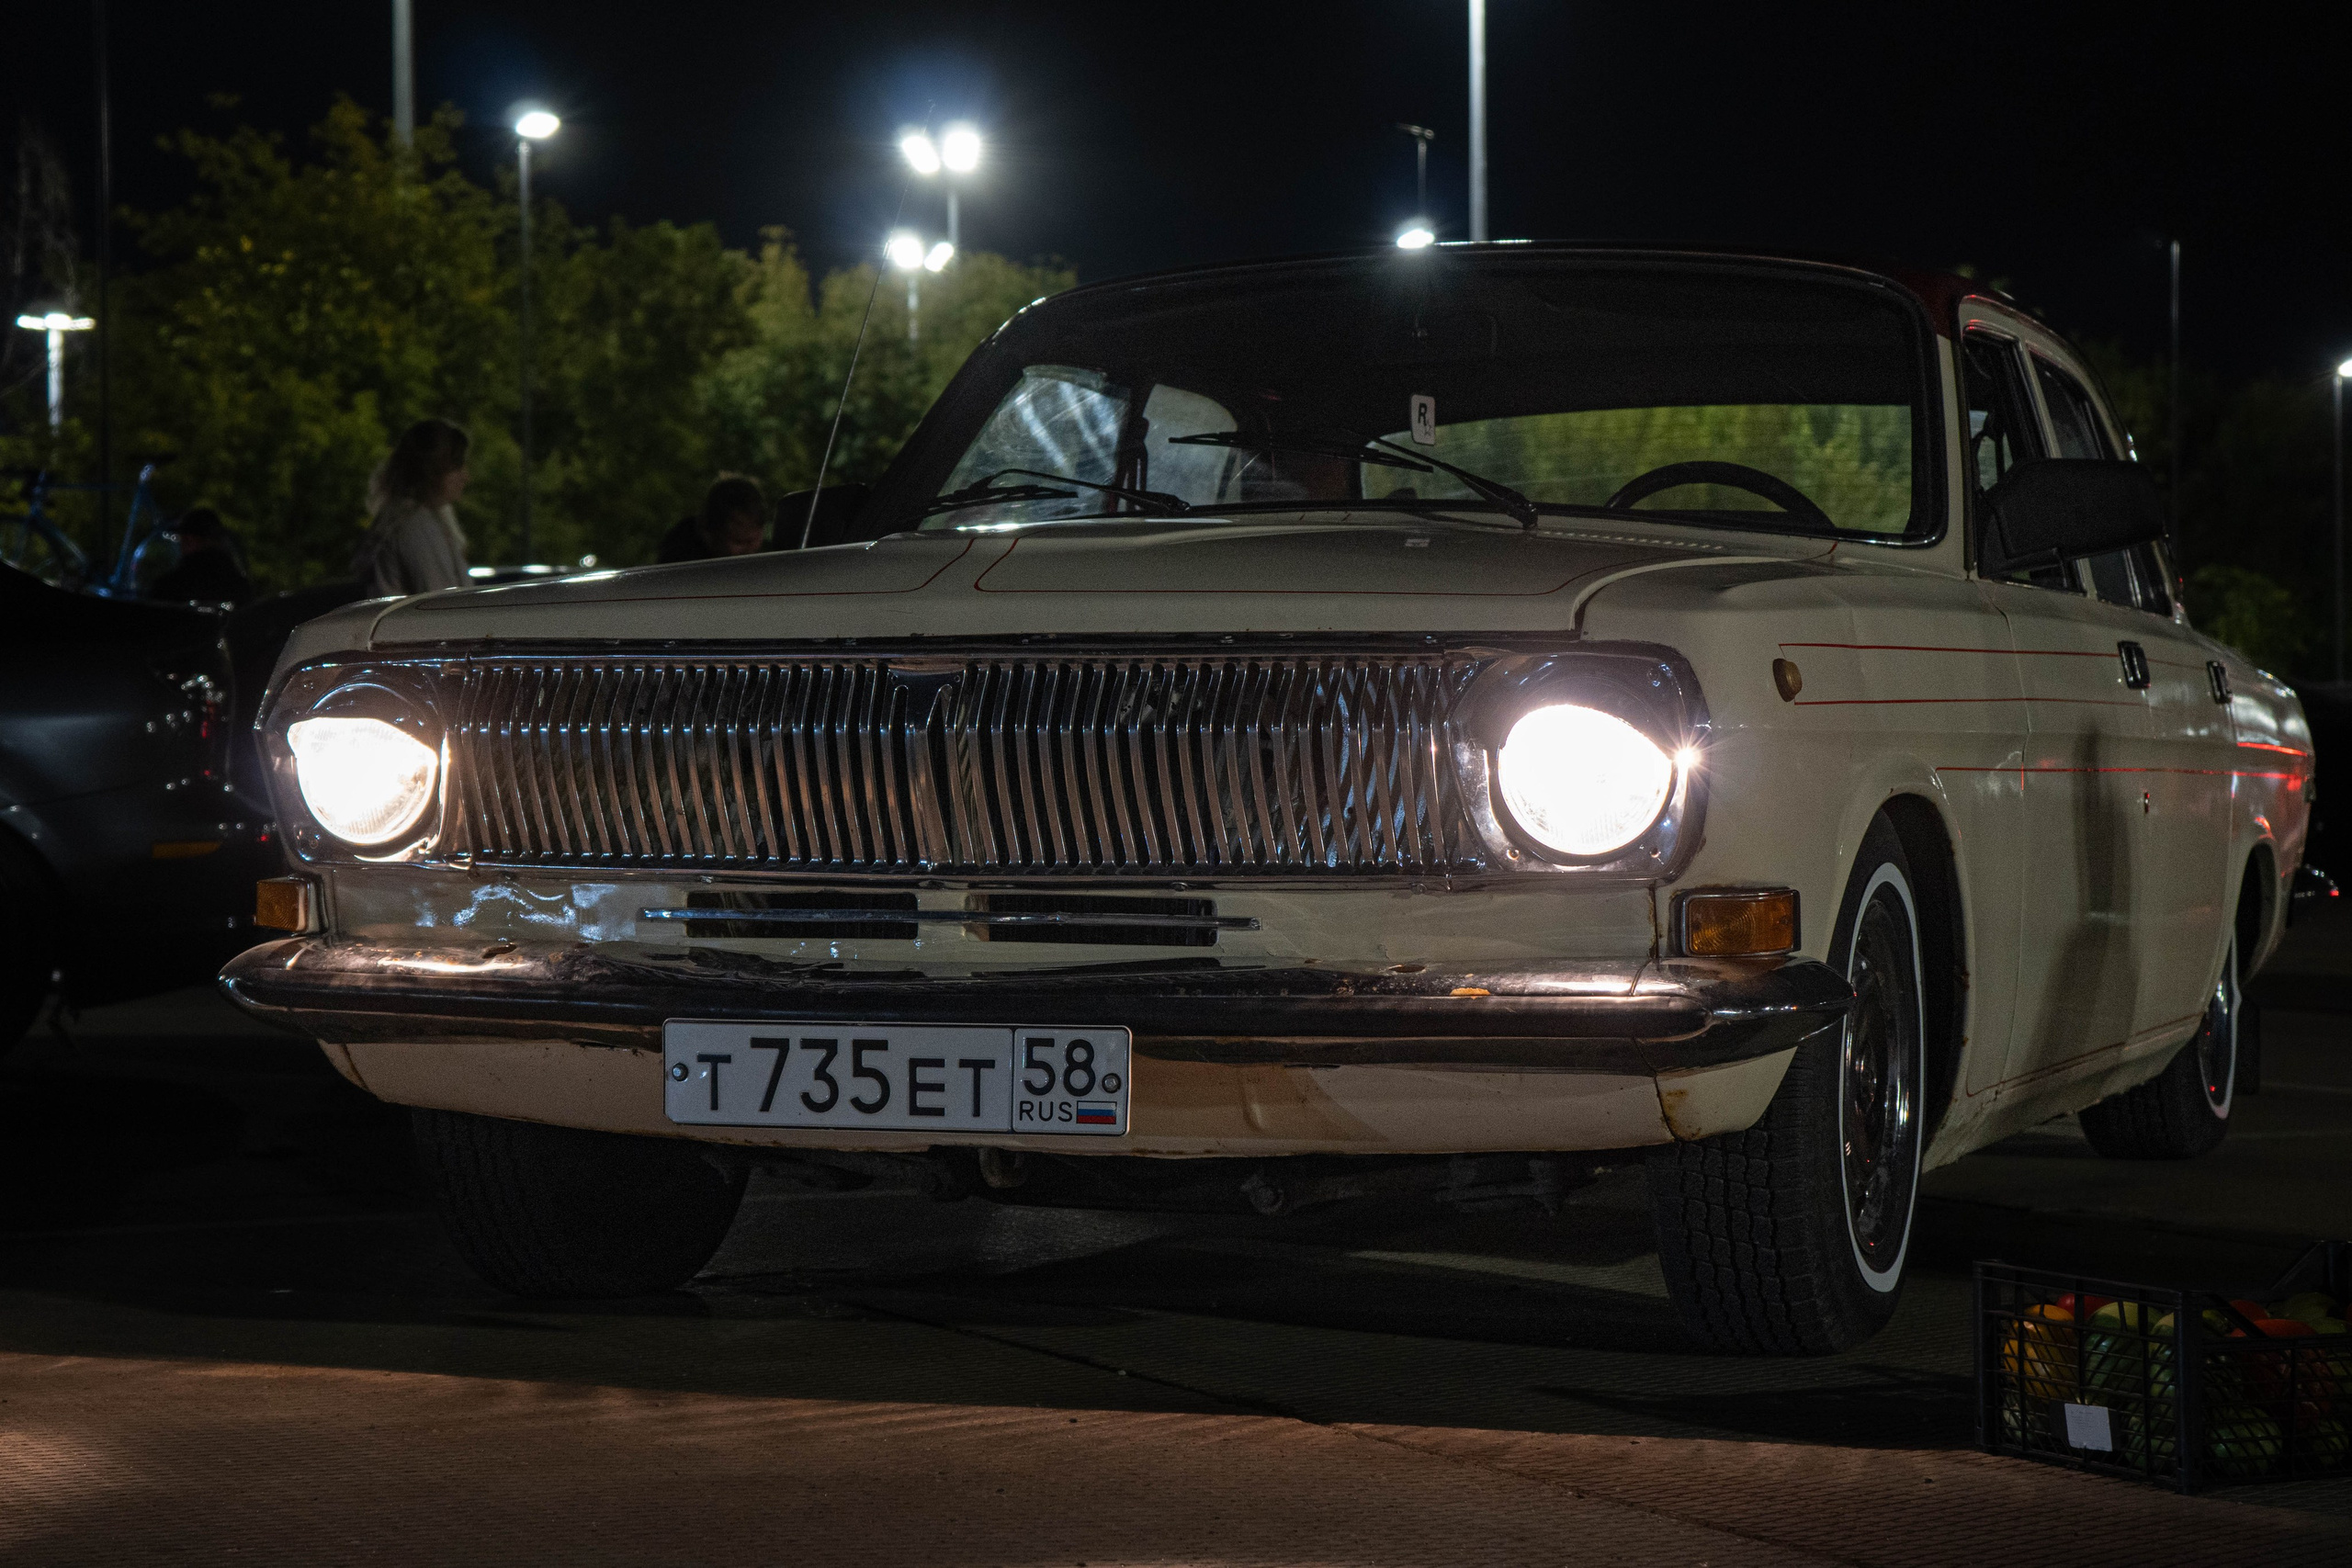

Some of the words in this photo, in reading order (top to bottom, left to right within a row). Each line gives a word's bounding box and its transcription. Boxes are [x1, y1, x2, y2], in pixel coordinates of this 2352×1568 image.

[1418, 402, 1428, 426] R
[1023, 1037, 1097, 1097] 58
[1018, 1100, 1073, 1122] RUS
